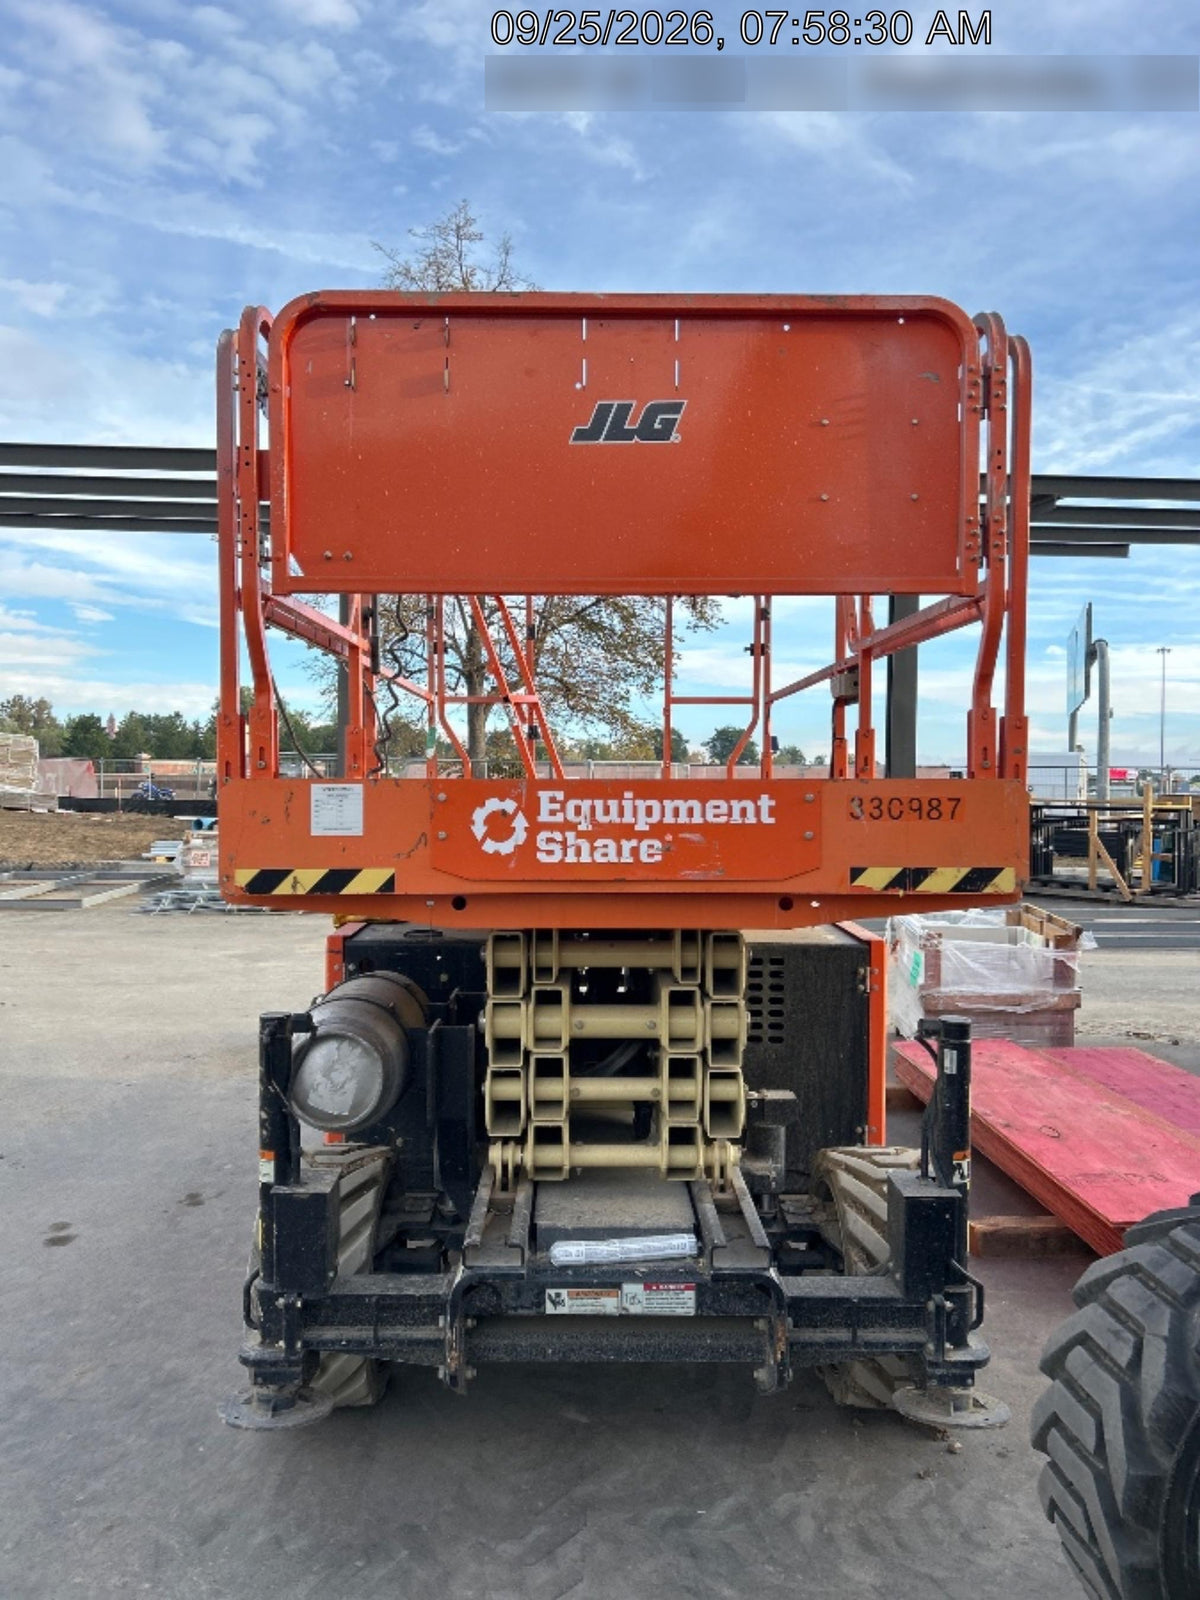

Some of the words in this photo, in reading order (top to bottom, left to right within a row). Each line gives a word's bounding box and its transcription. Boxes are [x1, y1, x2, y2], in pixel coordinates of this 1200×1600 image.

[569, 400, 688, 445] JLG
[536, 790, 777, 831] Equipment
[536, 831, 662, 864] Share
